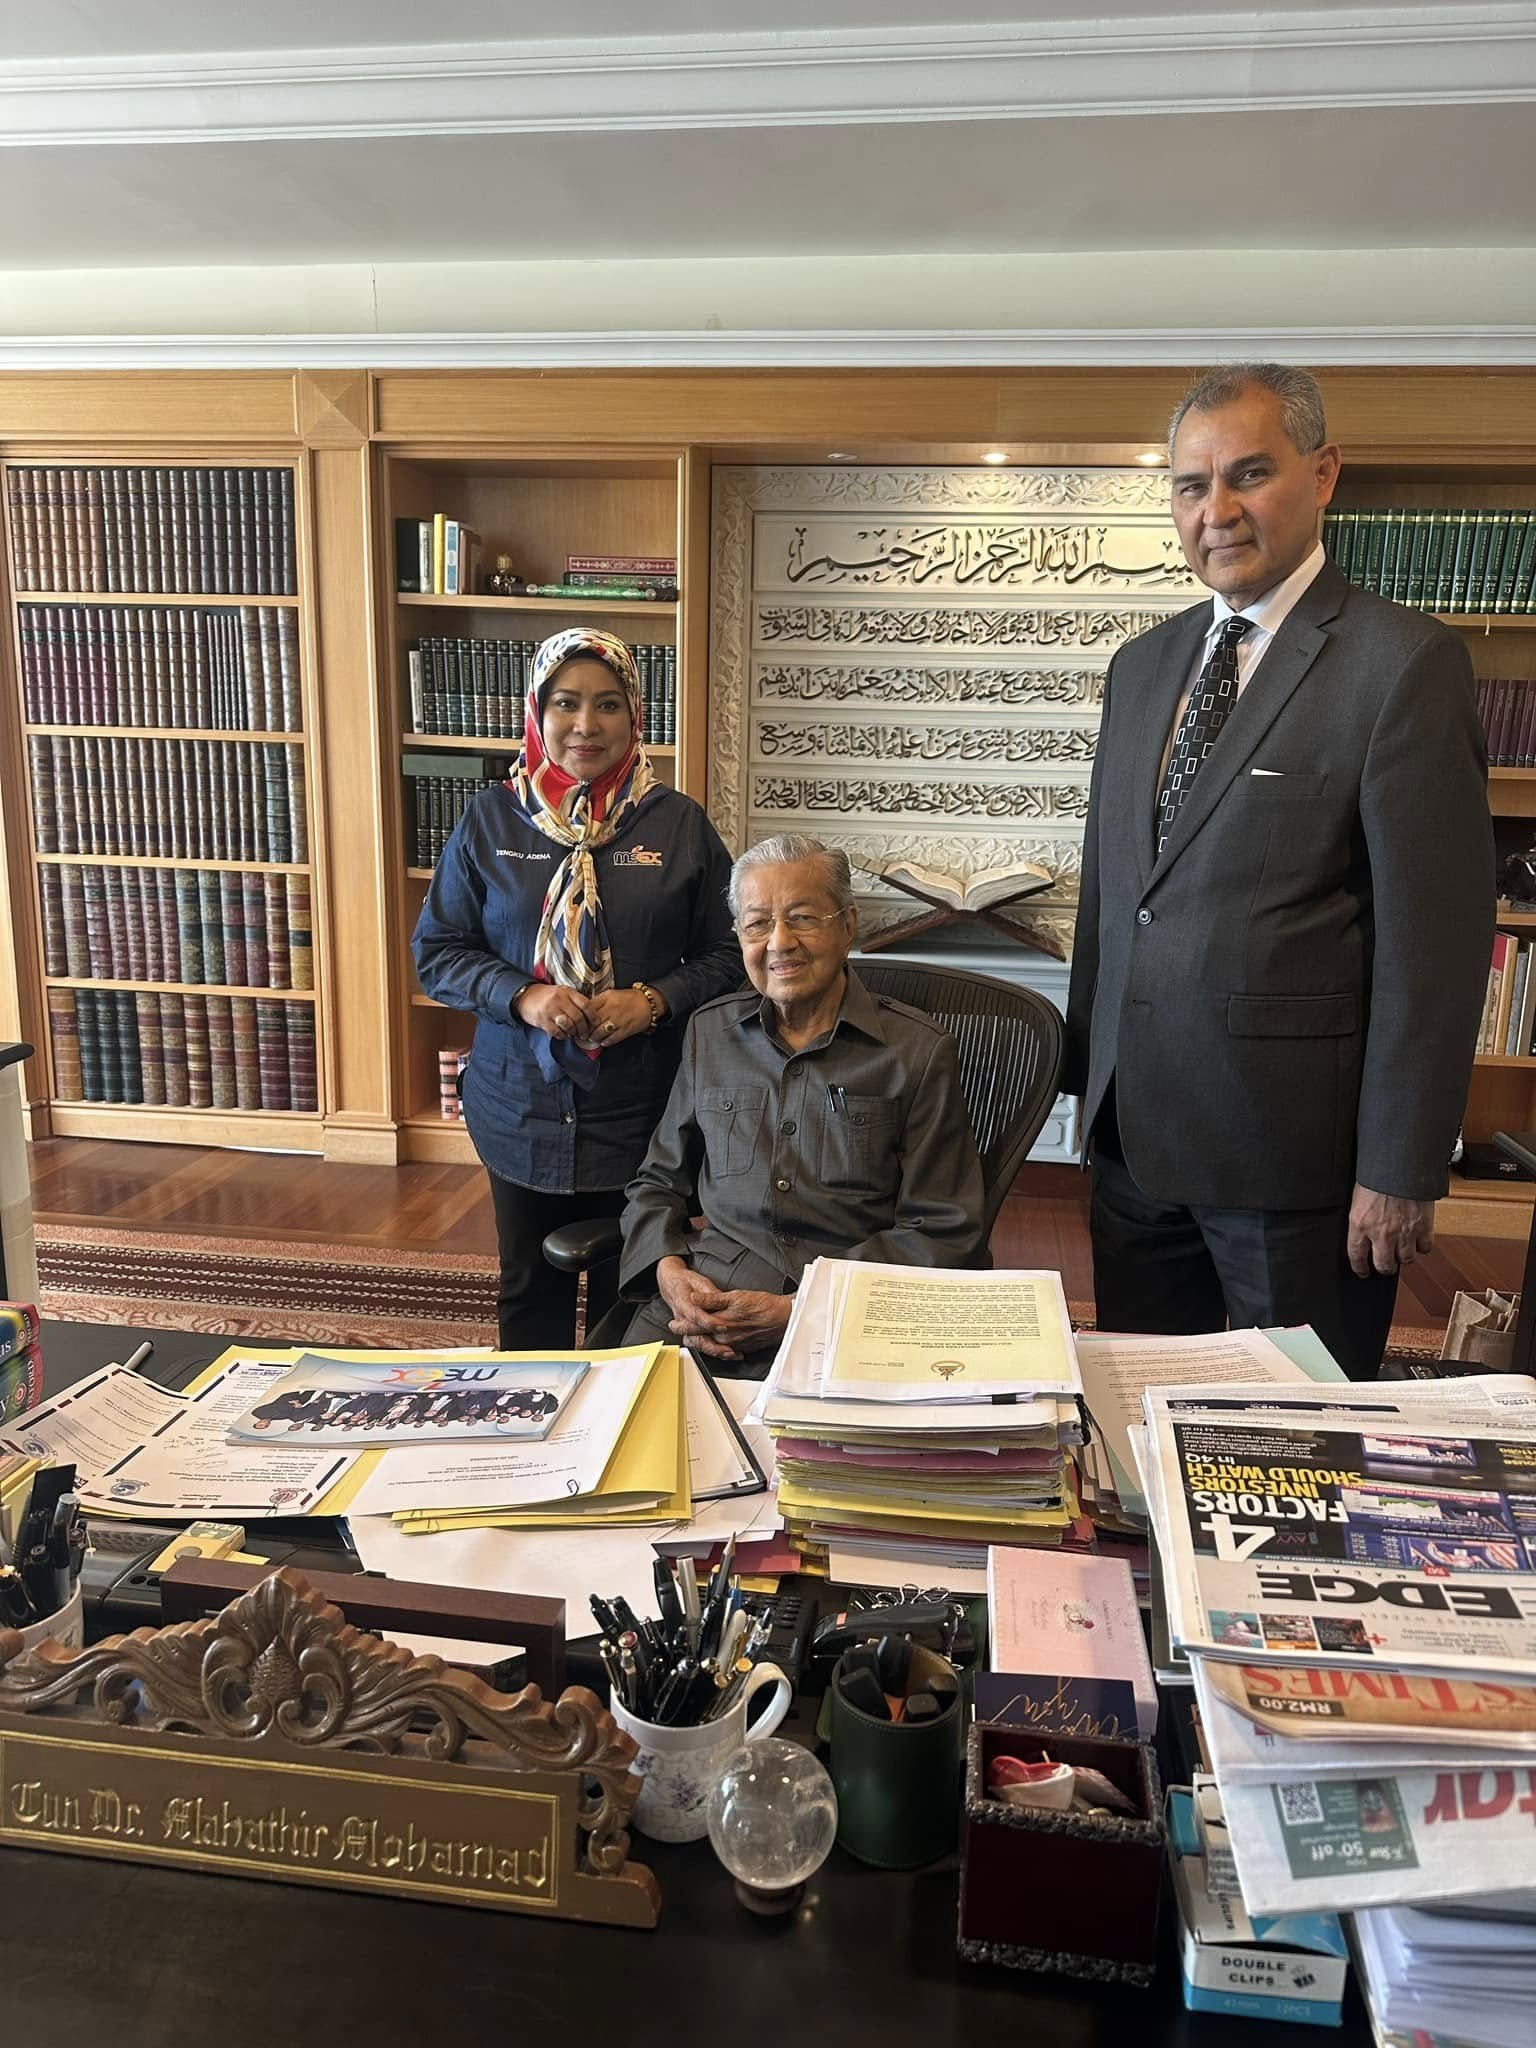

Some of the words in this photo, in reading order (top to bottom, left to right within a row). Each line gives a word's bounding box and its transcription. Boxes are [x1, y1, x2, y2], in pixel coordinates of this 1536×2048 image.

[496, 849, 525, 860] TENGKU
[526, 852, 551, 861] ADENA
[1185, 1452, 1214, 1463] 4Q
[1186, 1461, 1266, 1481] WATCH
[1268, 1466, 1364, 1487] SHOULD
[1188, 1476, 1319, 1499] INVESTORS
[1192, 1490, 1350, 1523] FACTORS
[1200, 1513, 1276, 1563] 4
[1255, 1563, 1407, 1580] MALAYSIA
[1255, 1571, 1524, 1620] EDGE
[1259, 1698, 1332, 1715] RM2.00
[10, 1781, 82, 1833] Tun
[88, 1788, 144, 1838] Dr.
[163, 1796, 329, 1860] Mahathir
[332, 1814, 549, 1889] Mohamad
[1311, 1843, 1334, 1862] off
[1220, 1955, 1286, 1972] DOUBLE
[1228, 1972, 1275, 1987] CLIPS
